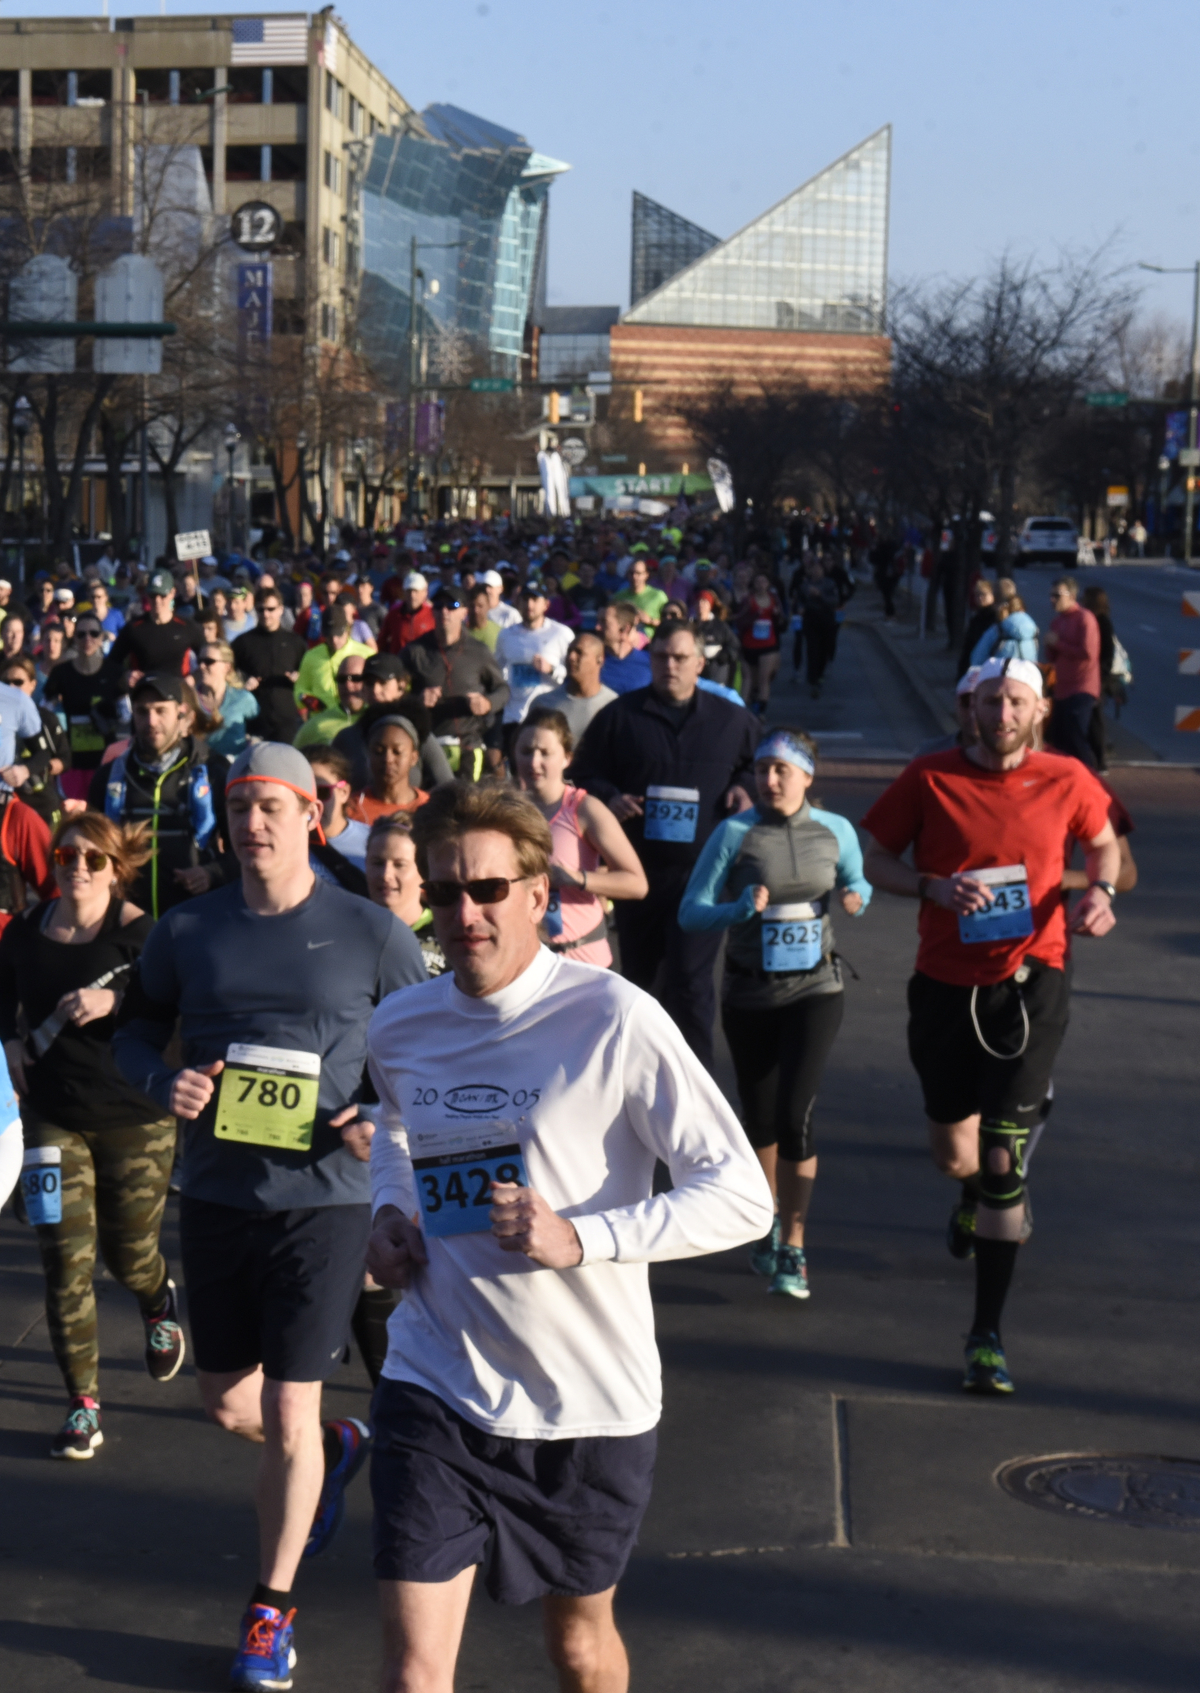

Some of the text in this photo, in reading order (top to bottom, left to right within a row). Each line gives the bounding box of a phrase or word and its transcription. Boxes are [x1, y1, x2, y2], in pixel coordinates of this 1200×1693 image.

[238, 208, 276, 243] 12
[615, 477, 671, 494] START
[648, 803, 694, 821] 2924
[767, 924, 819, 946] 2625
[238, 1076, 301, 1110] 780
[412, 1088, 438, 1106] 20
[512, 1089, 541, 1110] 05
